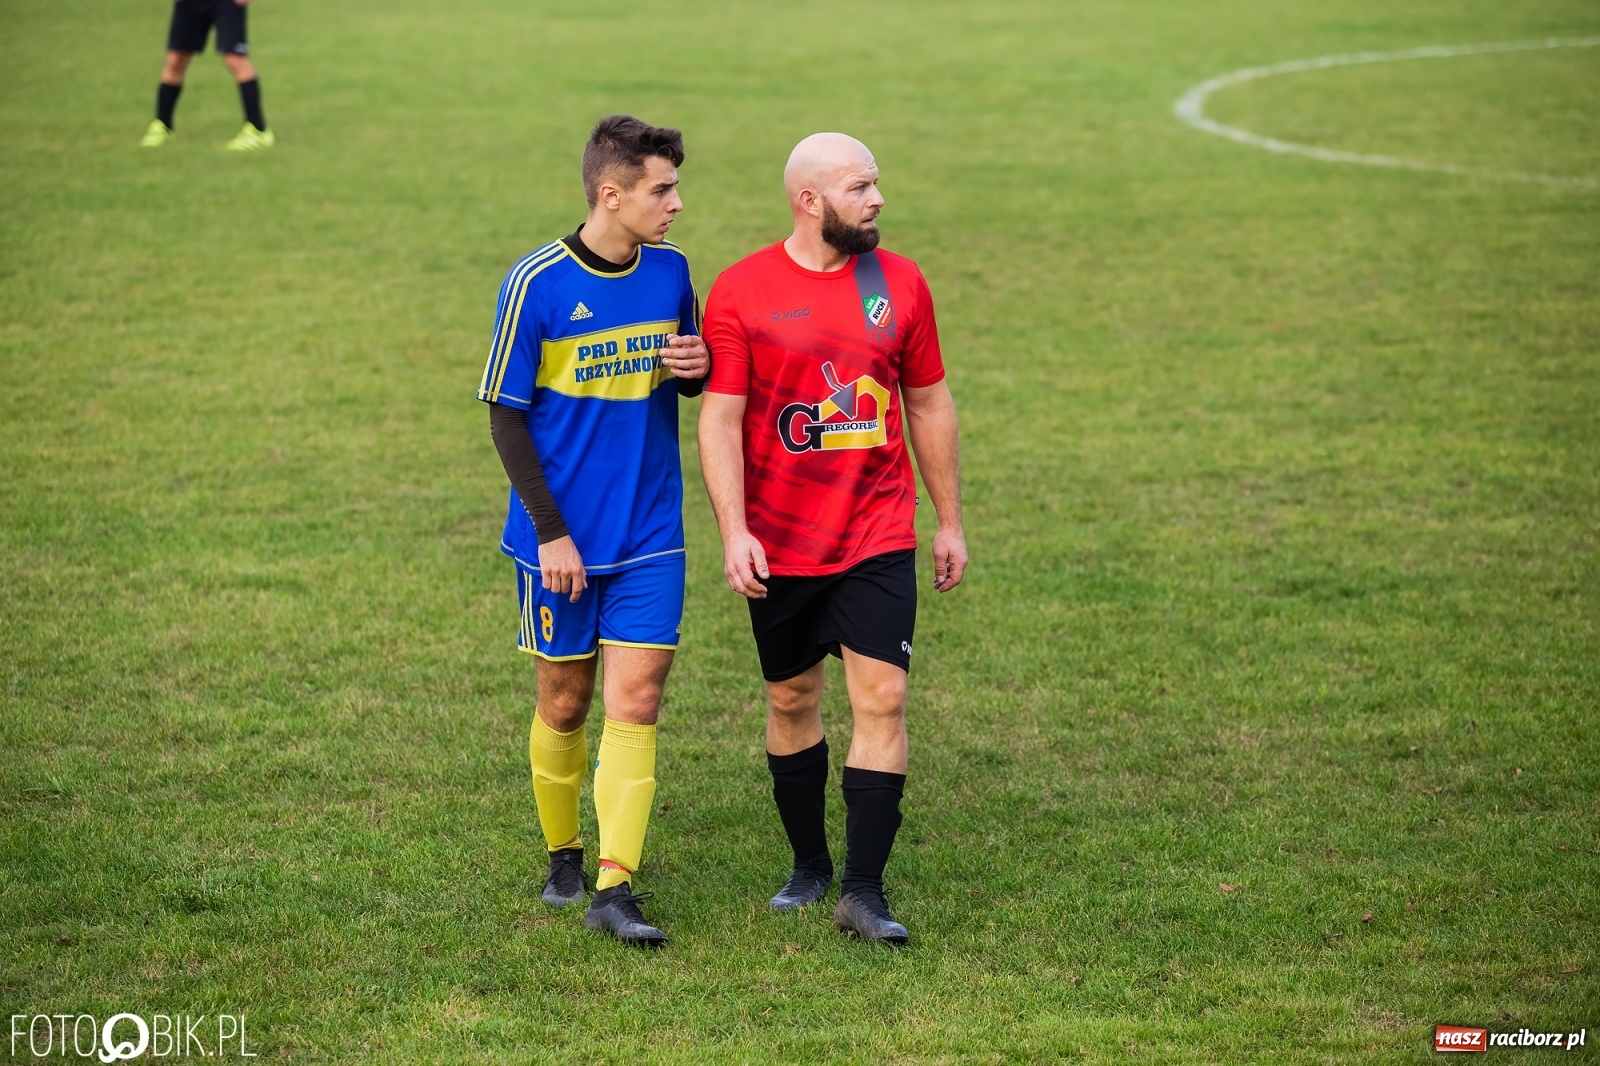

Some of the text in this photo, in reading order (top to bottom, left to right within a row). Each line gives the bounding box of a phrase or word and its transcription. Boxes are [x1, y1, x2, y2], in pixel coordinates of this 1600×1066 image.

[570, 311, 594, 321] adidas
[872, 301, 886, 320] RUCH
[577, 340, 619, 362] PRD
[540, 606, 553, 643] 8
